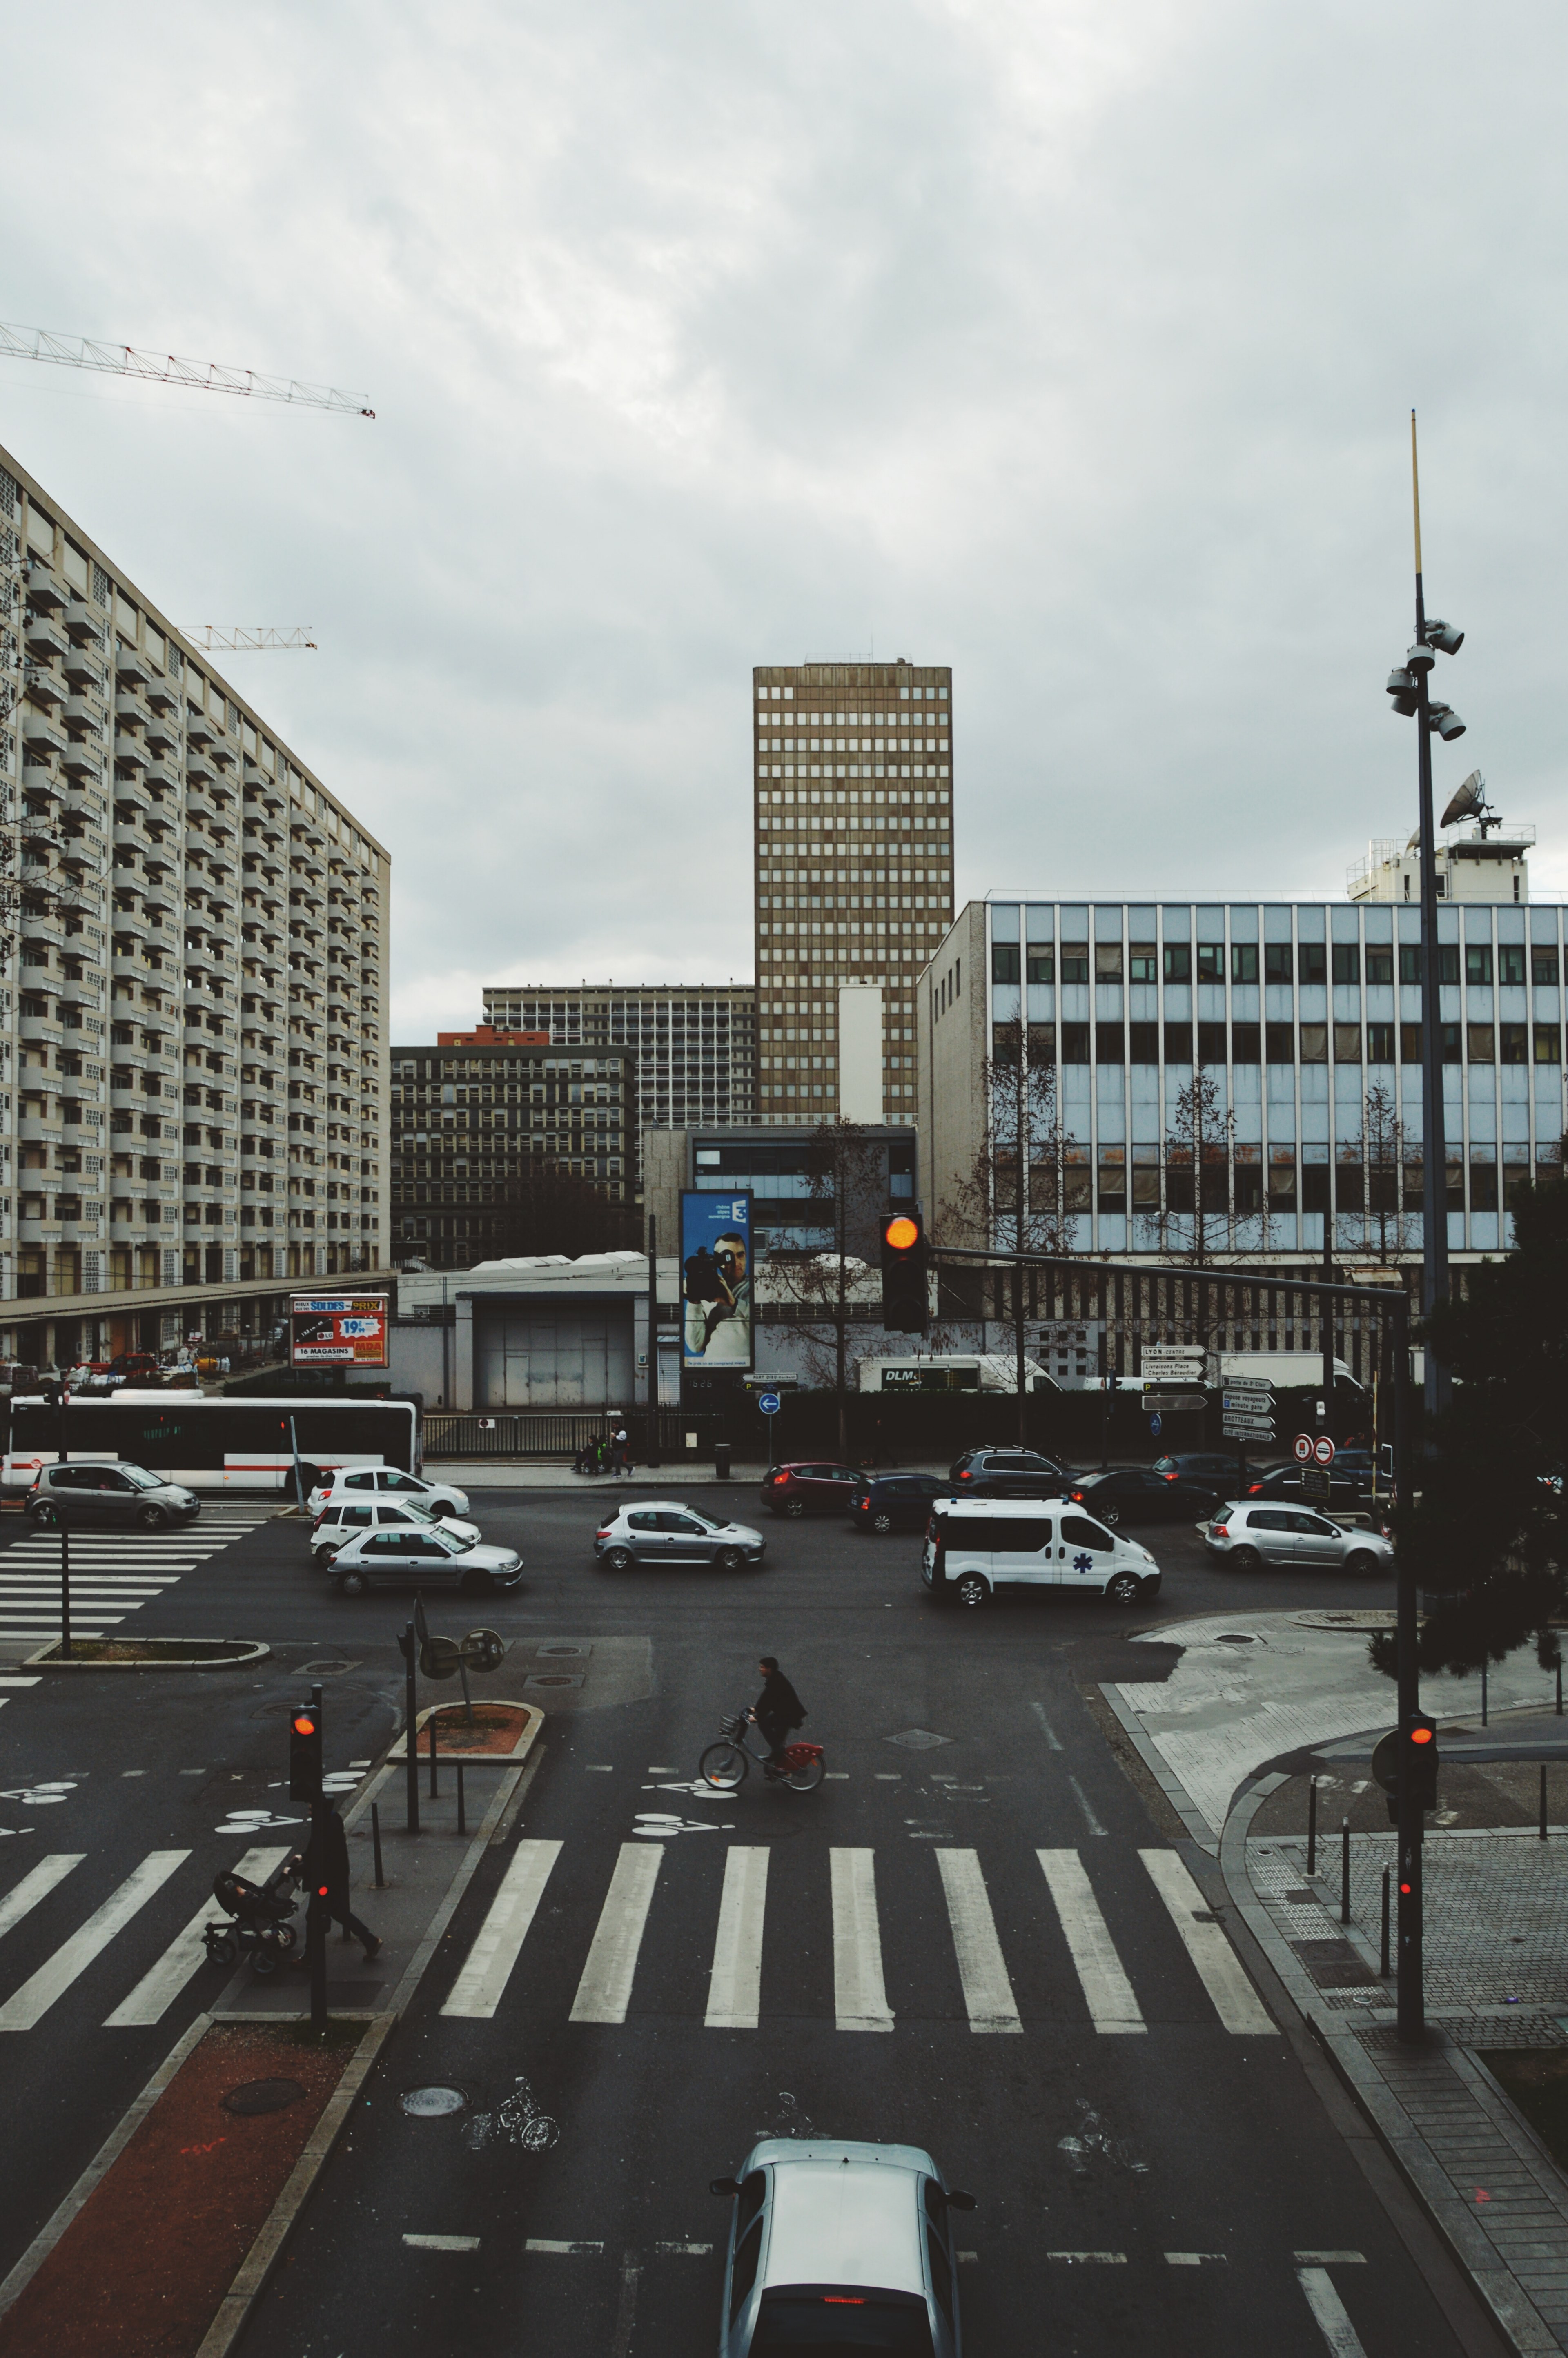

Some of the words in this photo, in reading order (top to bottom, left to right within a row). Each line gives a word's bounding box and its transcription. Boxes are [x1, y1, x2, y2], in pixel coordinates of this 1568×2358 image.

[311, 1301, 344, 1310] SOLDES
[352, 1301, 379, 1310] PRIX
[356, 1342, 381, 1350] MDA
[1224, 1415, 1254, 1424] BROTTEAUX
[1234, 1430, 1270, 1440] INTERNATIONALE
